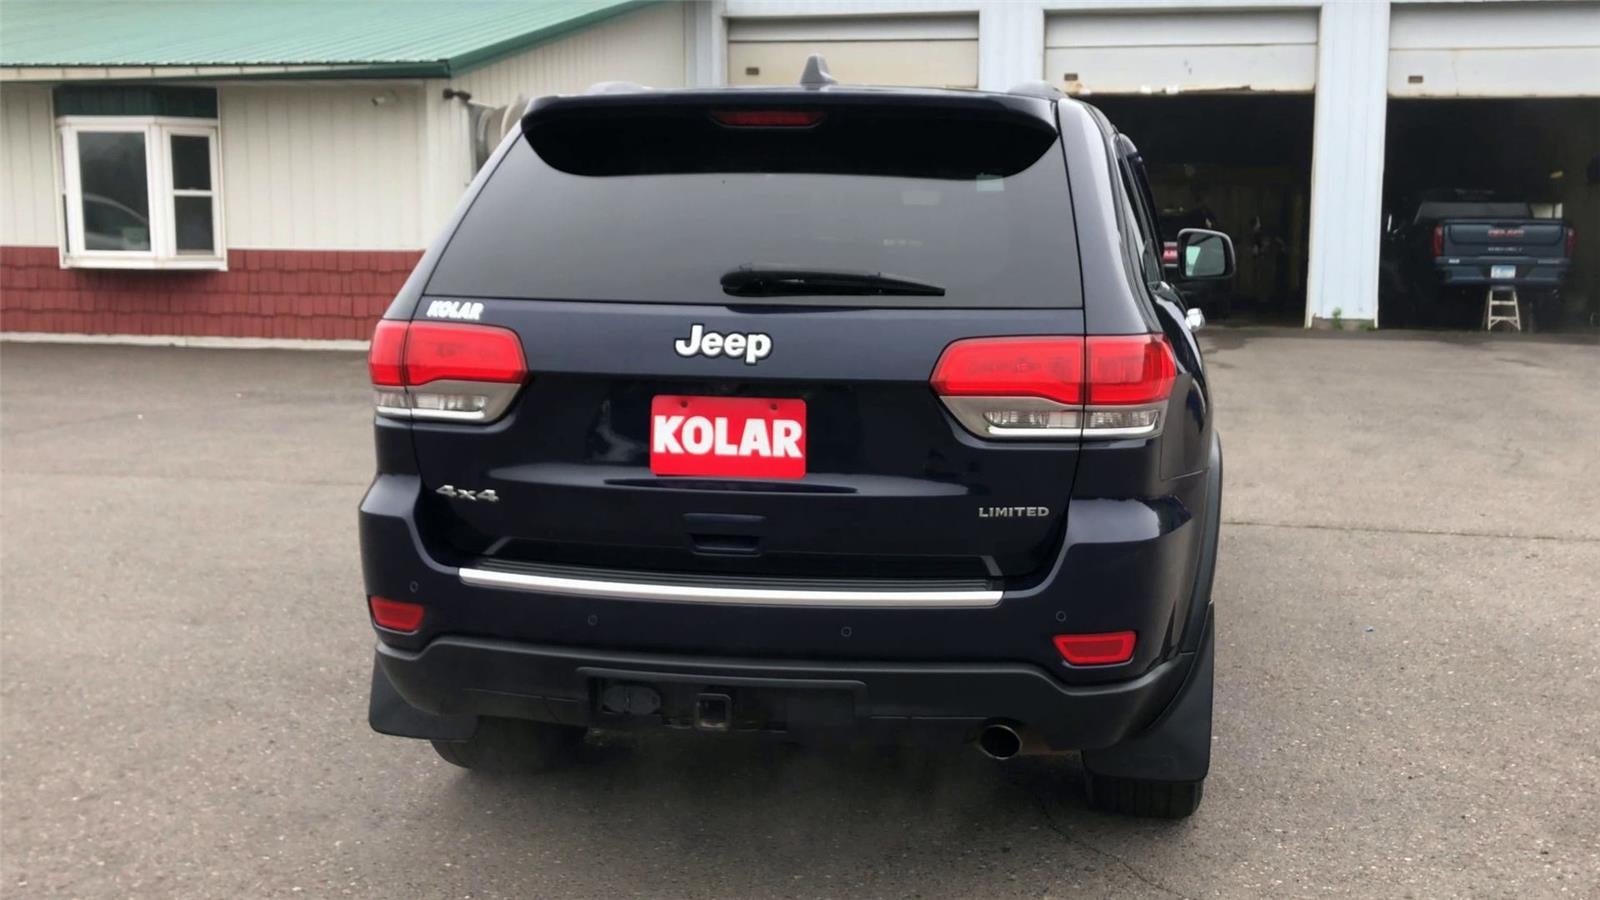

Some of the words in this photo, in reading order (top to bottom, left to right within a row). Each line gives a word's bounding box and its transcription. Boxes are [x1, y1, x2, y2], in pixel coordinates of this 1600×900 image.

[426, 300, 484, 320] KOLAR
[674, 324, 773, 365] Jeep
[653, 415, 803, 458] KOLAR
[978, 506, 1050, 518] LIMITED
